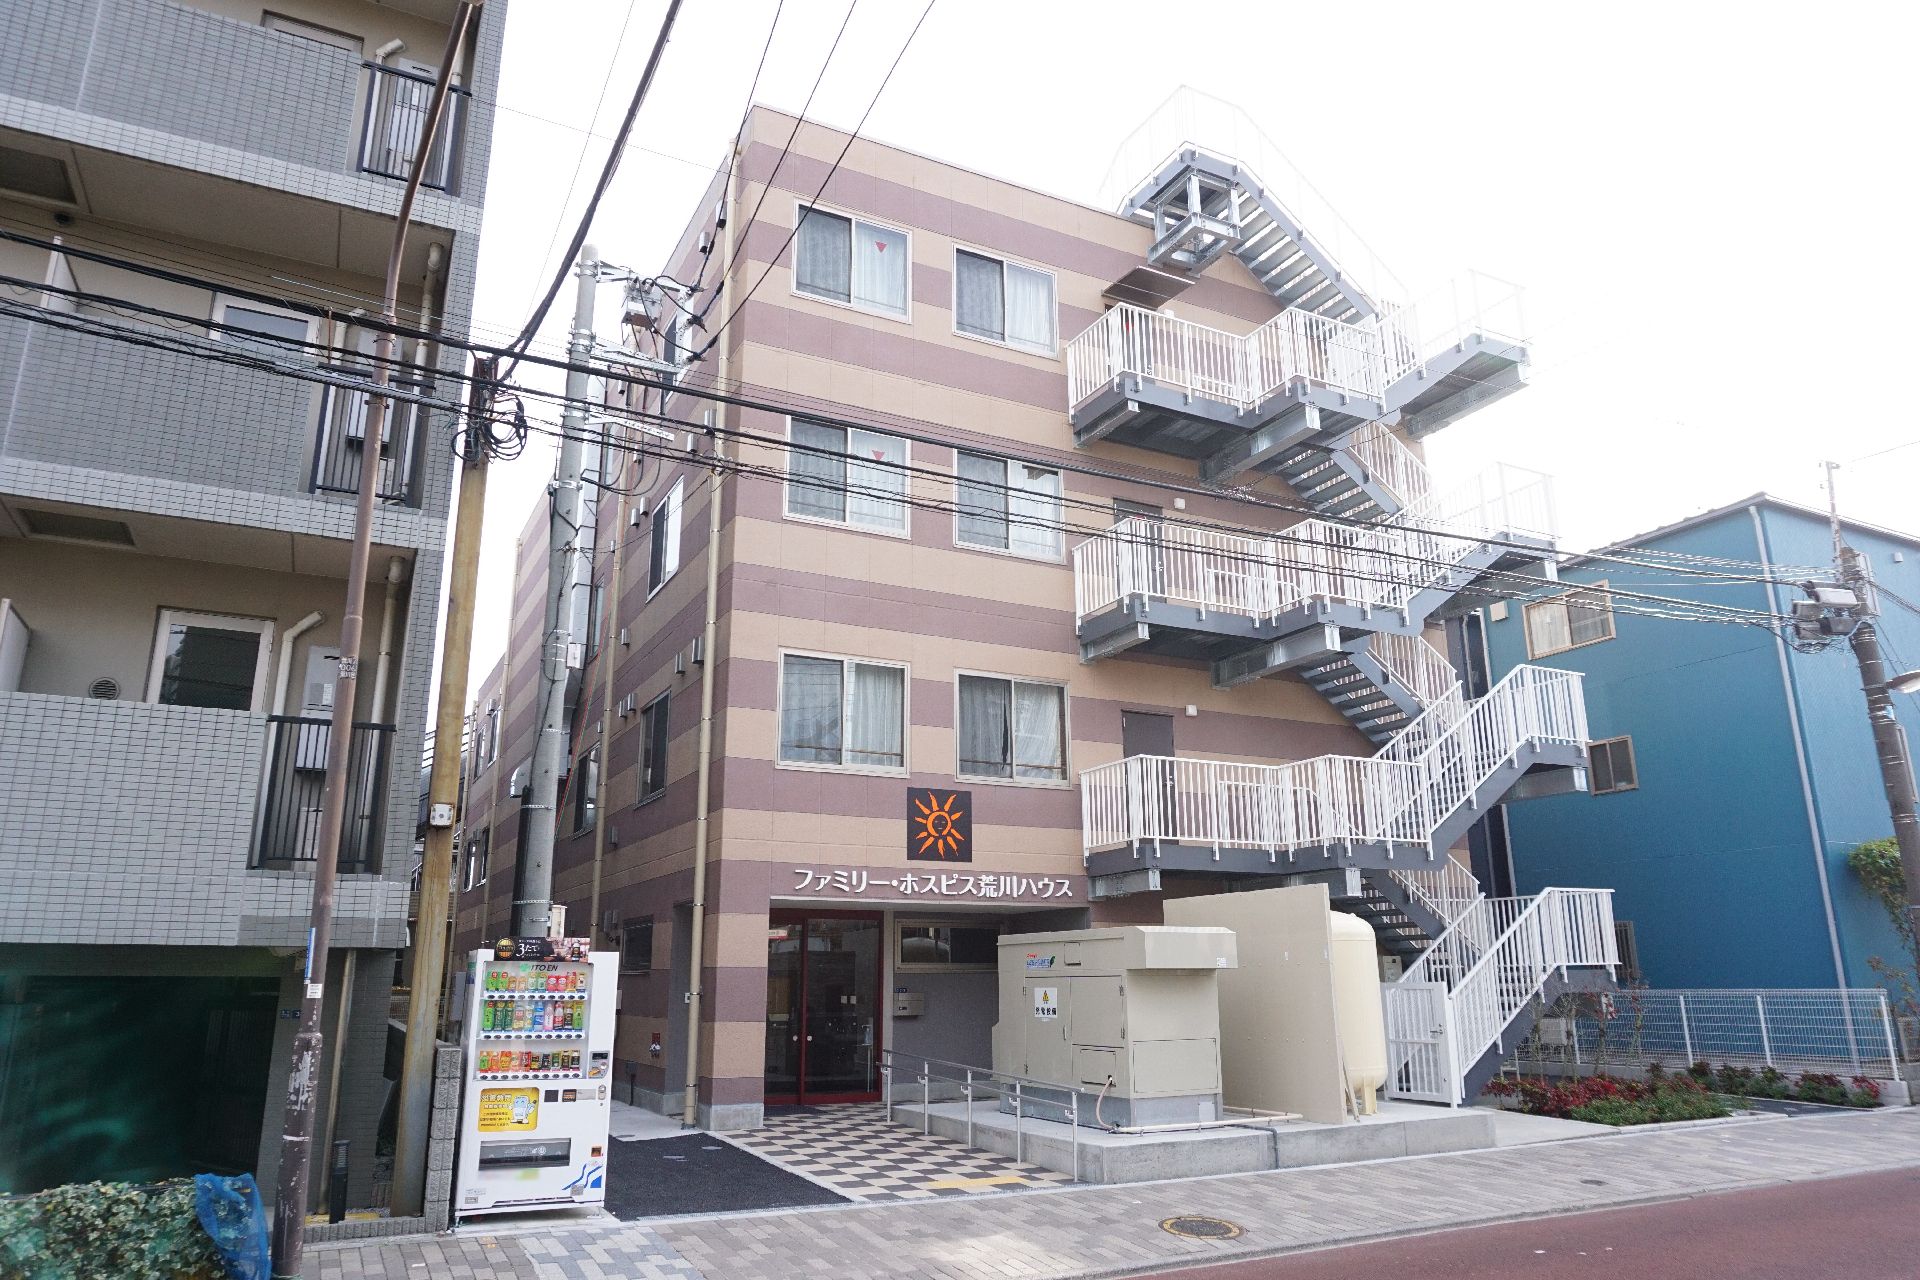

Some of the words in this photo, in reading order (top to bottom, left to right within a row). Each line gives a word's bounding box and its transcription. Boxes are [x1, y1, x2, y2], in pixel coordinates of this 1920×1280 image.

[794, 869, 1073, 898] ファミリー・ホスピス荒川ハウス
[531, 964, 546, 972] ITO
[547, 964, 559, 972] EN
